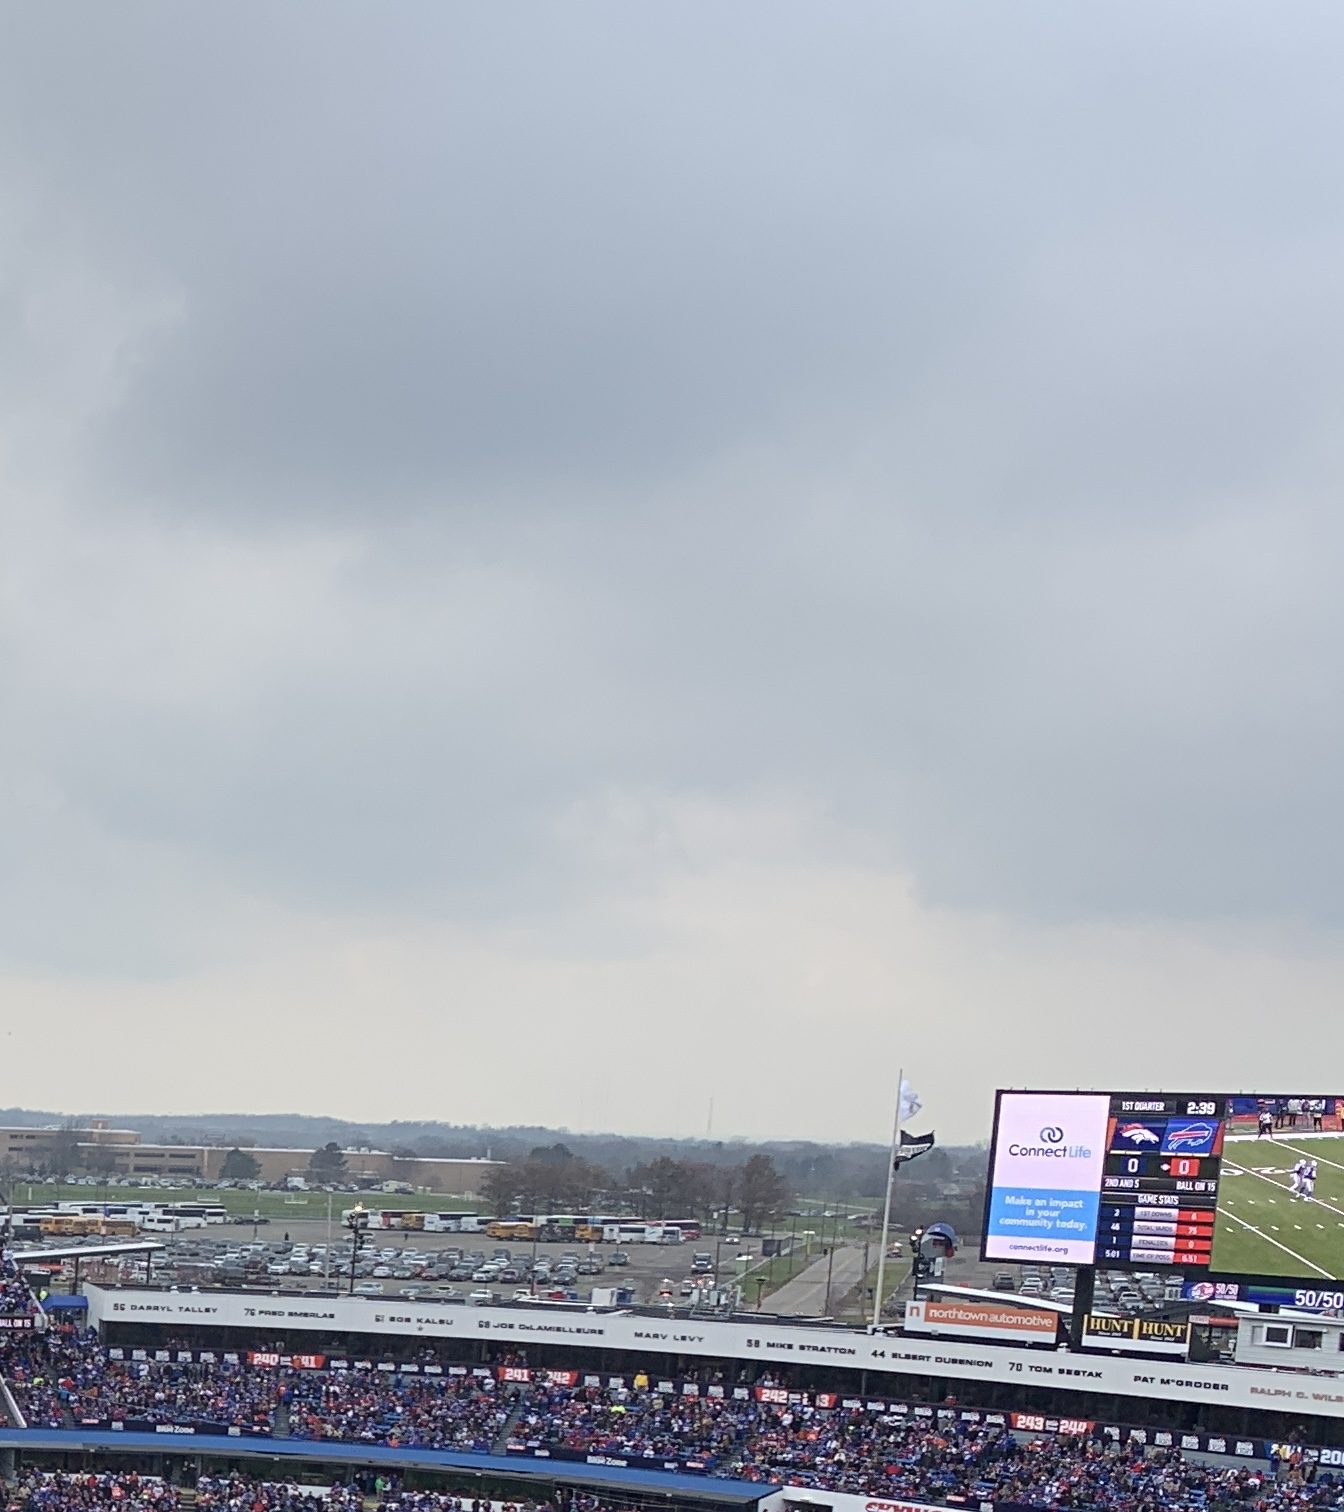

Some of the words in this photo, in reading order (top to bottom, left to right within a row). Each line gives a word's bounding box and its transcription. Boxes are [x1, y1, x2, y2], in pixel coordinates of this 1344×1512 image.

[1122, 1101, 1133, 1110] 1ST
[1135, 1102, 1164, 1111] QUARTER
[1187, 1102, 1215, 1114] 2:39
[1009, 1144, 1067, 1158] Connect
[1069, 1145, 1092, 1158] Life
[1127, 1159, 1138, 1173] 0
[1179, 1160, 1189, 1174] 0
[1105, 1179, 1119, 1188] 2ND
[1119, 1180, 1133, 1188] AND
[1134, 1180, 1140, 1188] 5
[1177, 1182, 1194, 1191] BALL
[1195, 1182, 1205, 1191] ON
[1207, 1183, 1216, 1192] 15
[1006, 1196, 1031, 1205] Make
[1035, 1198, 1047, 1206] an
[1050, 1196, 1083, 1210] impact
[1138, 1195, 1158, 1204] GAME
[1159, 1196, 1179, 1205] STATS
[1026, 1207, 1034, 1216] in
[1037, 1209, 1061, 1219] your
[999, 1217, 1053, 1229] community
[1056, 1219, 1088, 1232] today.
[1009, 1243, 1069, 1255] connectlife.org
[1216, 1283, 1239, 1295] 50/50
[1295, 1289, 1344, 1309] 50/50
[130, 1304, 173, 1312] DARRYL
[288, 1311, 335, 1319] SMERLAS
[416, 1317, 454, 1325] KALSU
[928, 1306, 988, 1322] northtown
[990, 1311, 1052, 1327] automotive
[1090, 1317, 1134, 1333] HUNT
[1142, 1322, 1186, 1337] HUNT
[634, 1331, 668, 1340] MARV
[673, 1334, 704, 1342] LEVY
[746, 1339, 760, 1348] 58
[766, 1341, 793, 1350] MIKE
[799, 1344, 856, 1355] STRATTON
[253, 1353, 279, 1366] 240
[871, 1349, 885, 1358] 44
[891, 1352, 932, 1362] ELBERT
[935, 1356, 993, 1368] DUBENION
[504, 1369, 529, 1382] 241
[1008, 1362, 1023, 1372] 70
[1028, 1365, 1053, 1374] TOM
[1058, 1368, 1103, 1379] SESTAK
[1133, 1375, 1156, 1384] PAT
[761, 1389, 788, 1404] 242
[1250, 1387, 1291, 1397] RALPH
[1017, 1414, 1044, 1431] 243
[1060, 1418, 1088, 1435] 244
